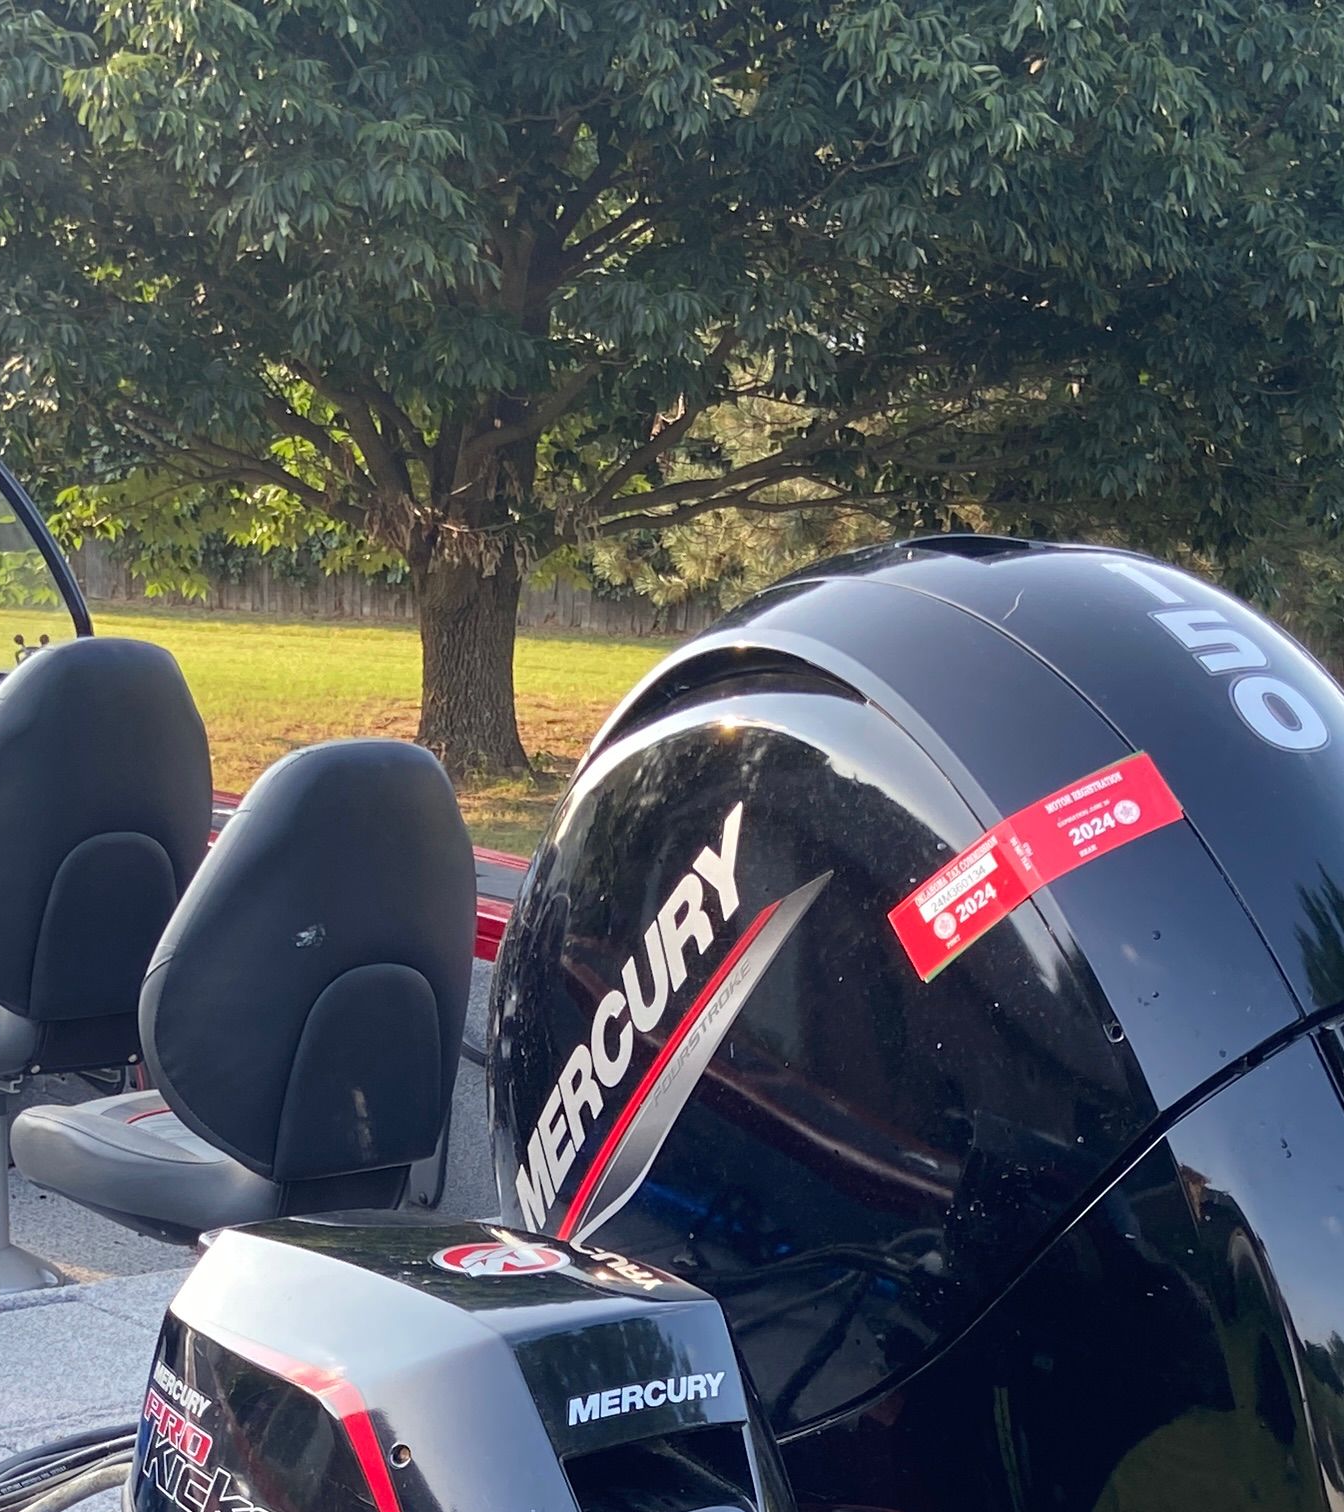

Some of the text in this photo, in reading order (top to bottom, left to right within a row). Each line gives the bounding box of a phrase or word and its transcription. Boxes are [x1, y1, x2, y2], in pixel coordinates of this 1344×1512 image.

[1101, 562, 1330, 751] 150
[1044, 769, 1124, 814] MOTOR REGISTRATION
[1068, 812, 1116, 846] 2024
[955, 882, 997, 923] 2024
[515, 801, 742, 1233] MERCURY
[652, 958, 752, 1107] FOURSTROKE
[153, 1360, 212, 1418] MERCURY
[568, 1372, 725, 1427] MERCURY
[143, 1387, 214, 1467] PRO
